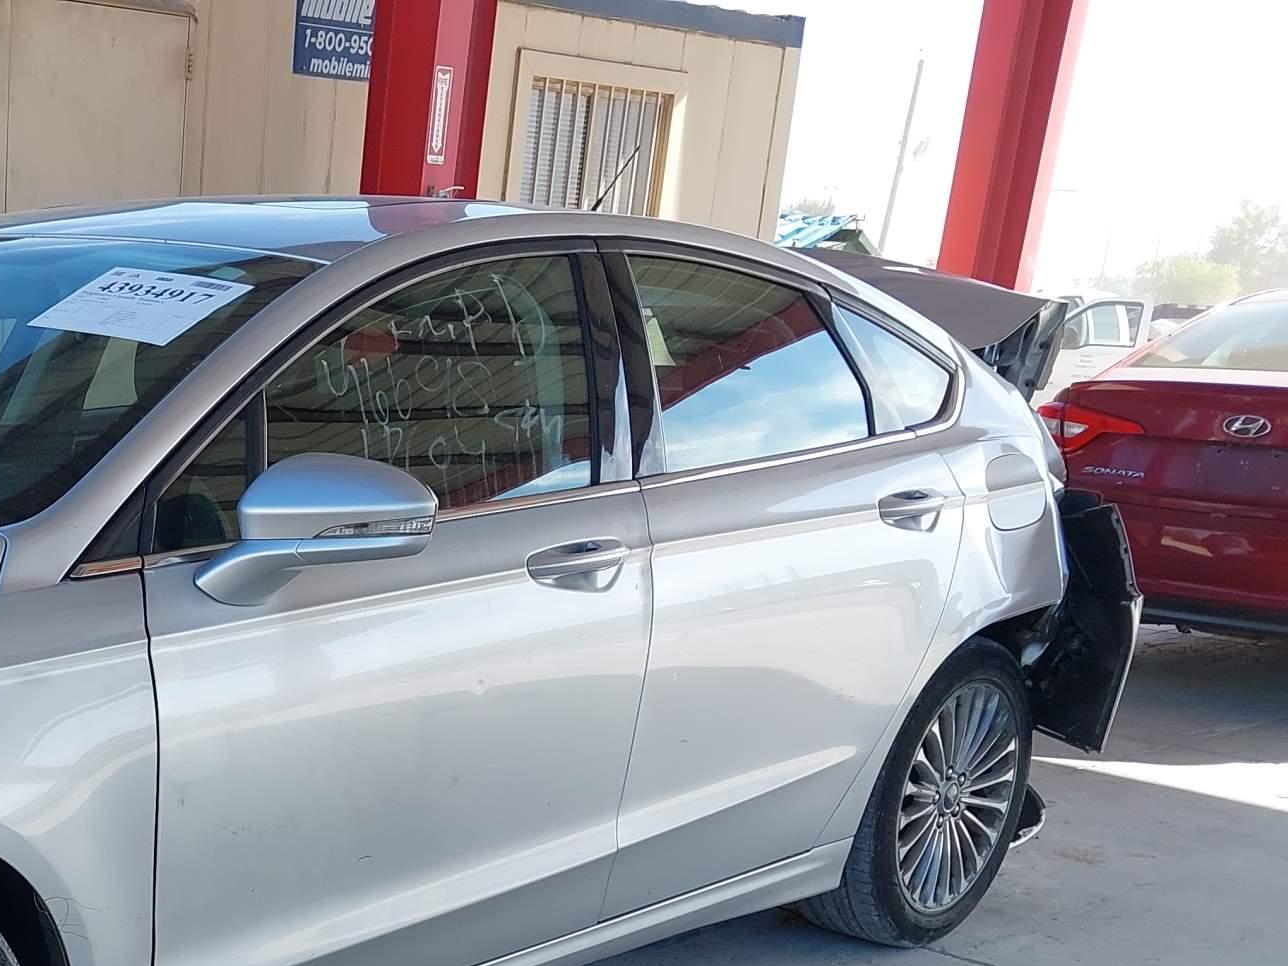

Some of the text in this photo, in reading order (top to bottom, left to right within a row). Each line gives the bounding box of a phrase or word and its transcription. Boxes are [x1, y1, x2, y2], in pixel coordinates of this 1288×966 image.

[309, 55, 371, 79] mobilemi
[98, 280, 216, 306] 43934917
[1081, 465, 1146, 479] SONATA
